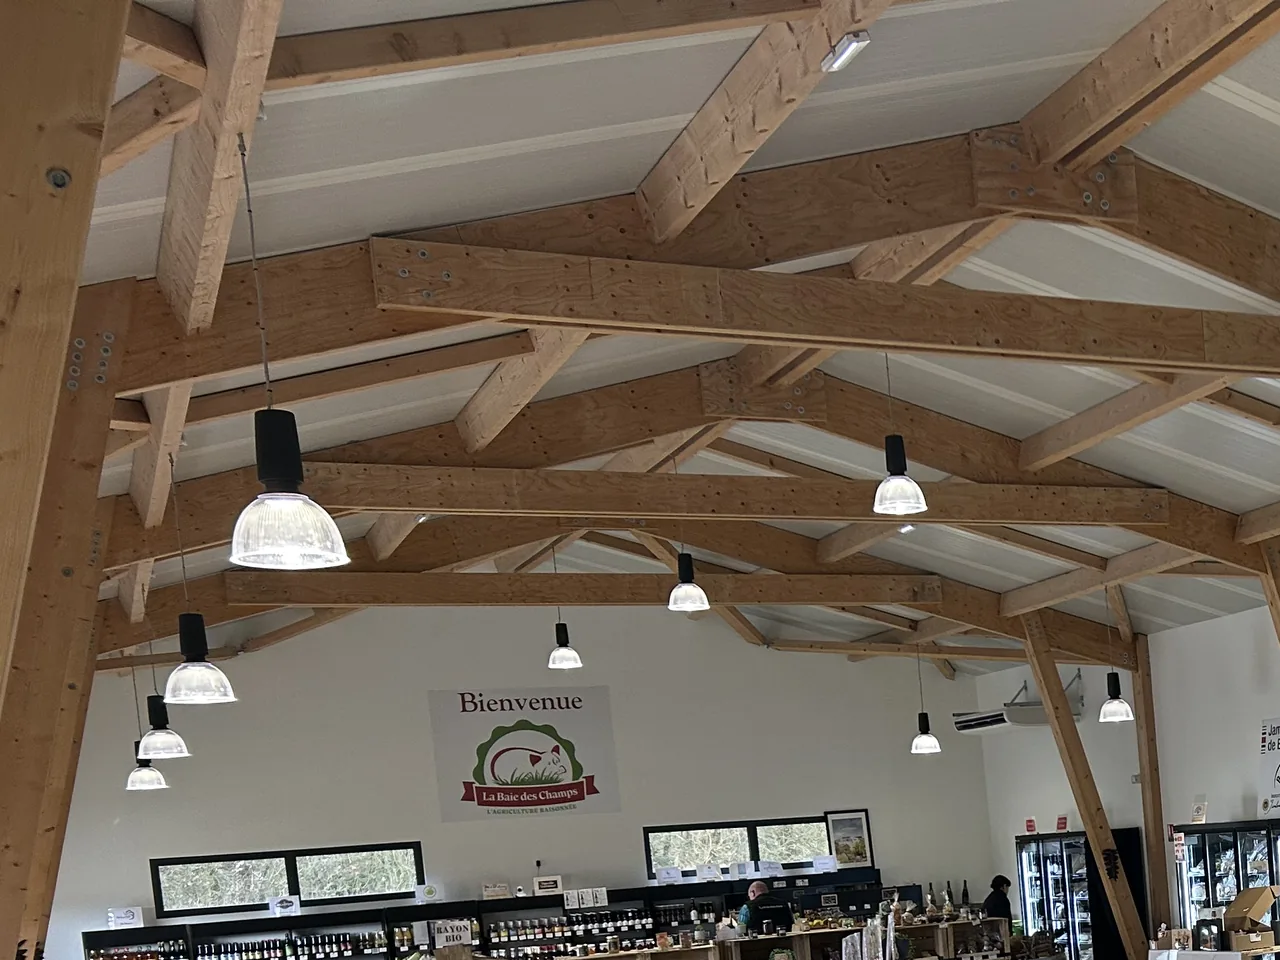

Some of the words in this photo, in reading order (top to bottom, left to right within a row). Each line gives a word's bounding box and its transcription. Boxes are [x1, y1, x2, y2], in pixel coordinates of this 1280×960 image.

[458, 691, 583, 713] Bienvenue
[1267, 740, 1276, 751] de
[482, 791, 495, 802] La
[497, 791, 519, 802] Baie
[520, 791, 537, 801] des
[538, 788, 579, 800] Champs
[486, 807, 539, 815] L'AGRICULTURE
[436, 925, 469, 934] RAYON
[445, 934, 462, 942] BIO
